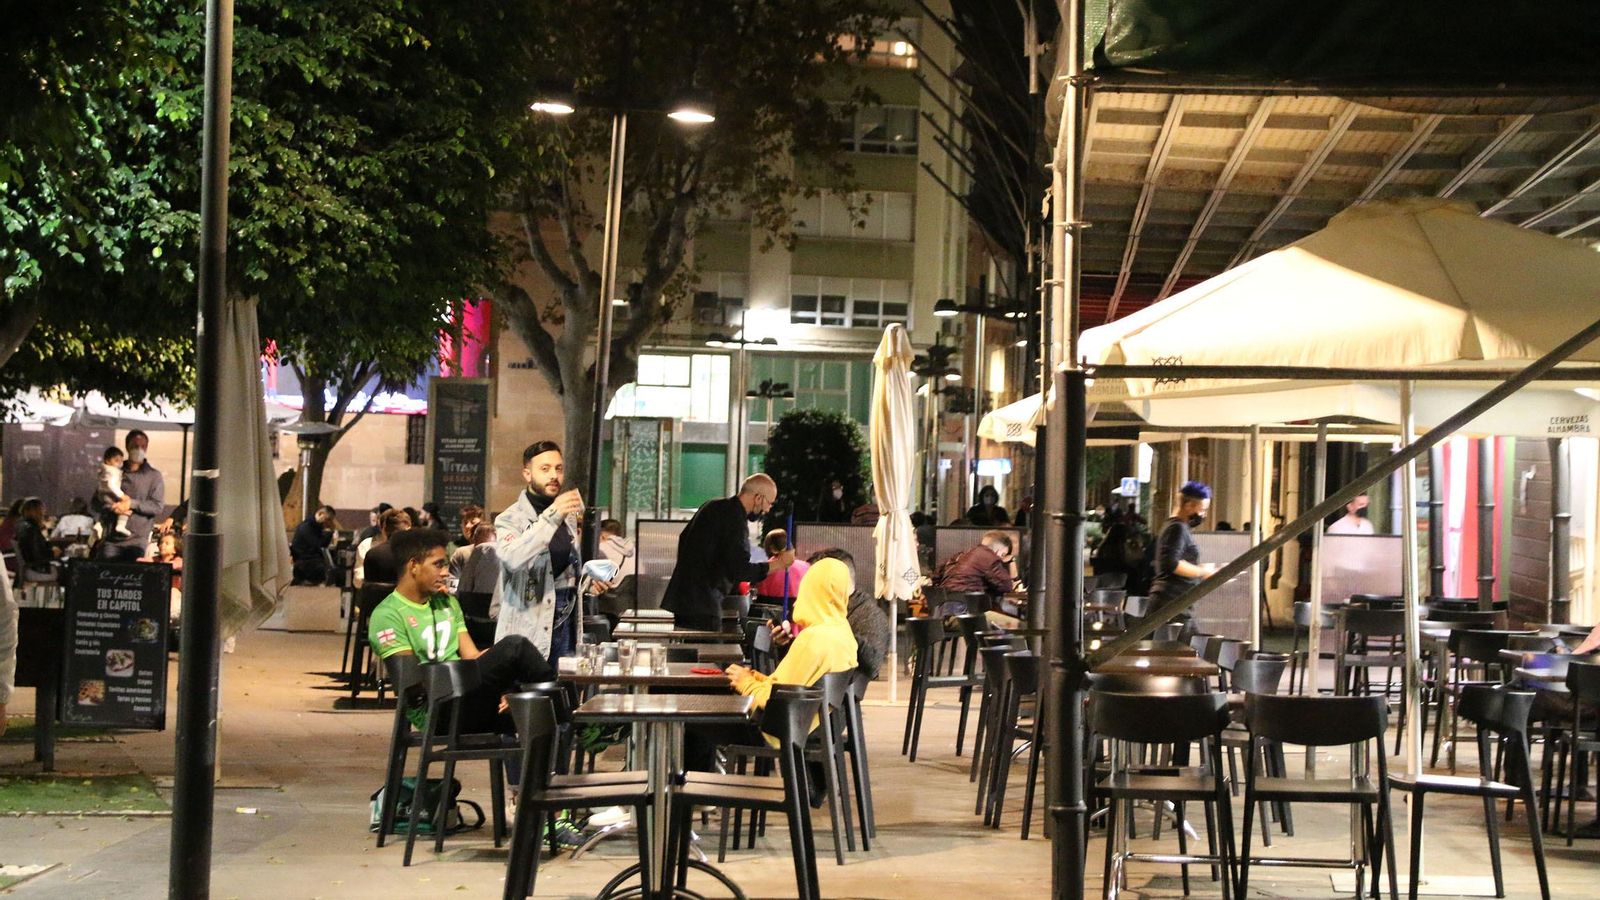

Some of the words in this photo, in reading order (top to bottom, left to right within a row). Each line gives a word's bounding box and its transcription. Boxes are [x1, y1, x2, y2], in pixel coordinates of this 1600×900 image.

[1550, 415, 1589, 424] CERVEZAS
[1548, 424, 1591, 433] ALHAMBRA
[438, 457, 479, 473] TITAN
[97, 588, 112, 599] TUS
[114, 589, 143, 600] TARDES
[97, 599, 108, 610] EN
[109, 600, 142, 611] CAPITOL
[421, 620, 451, 660] 17
